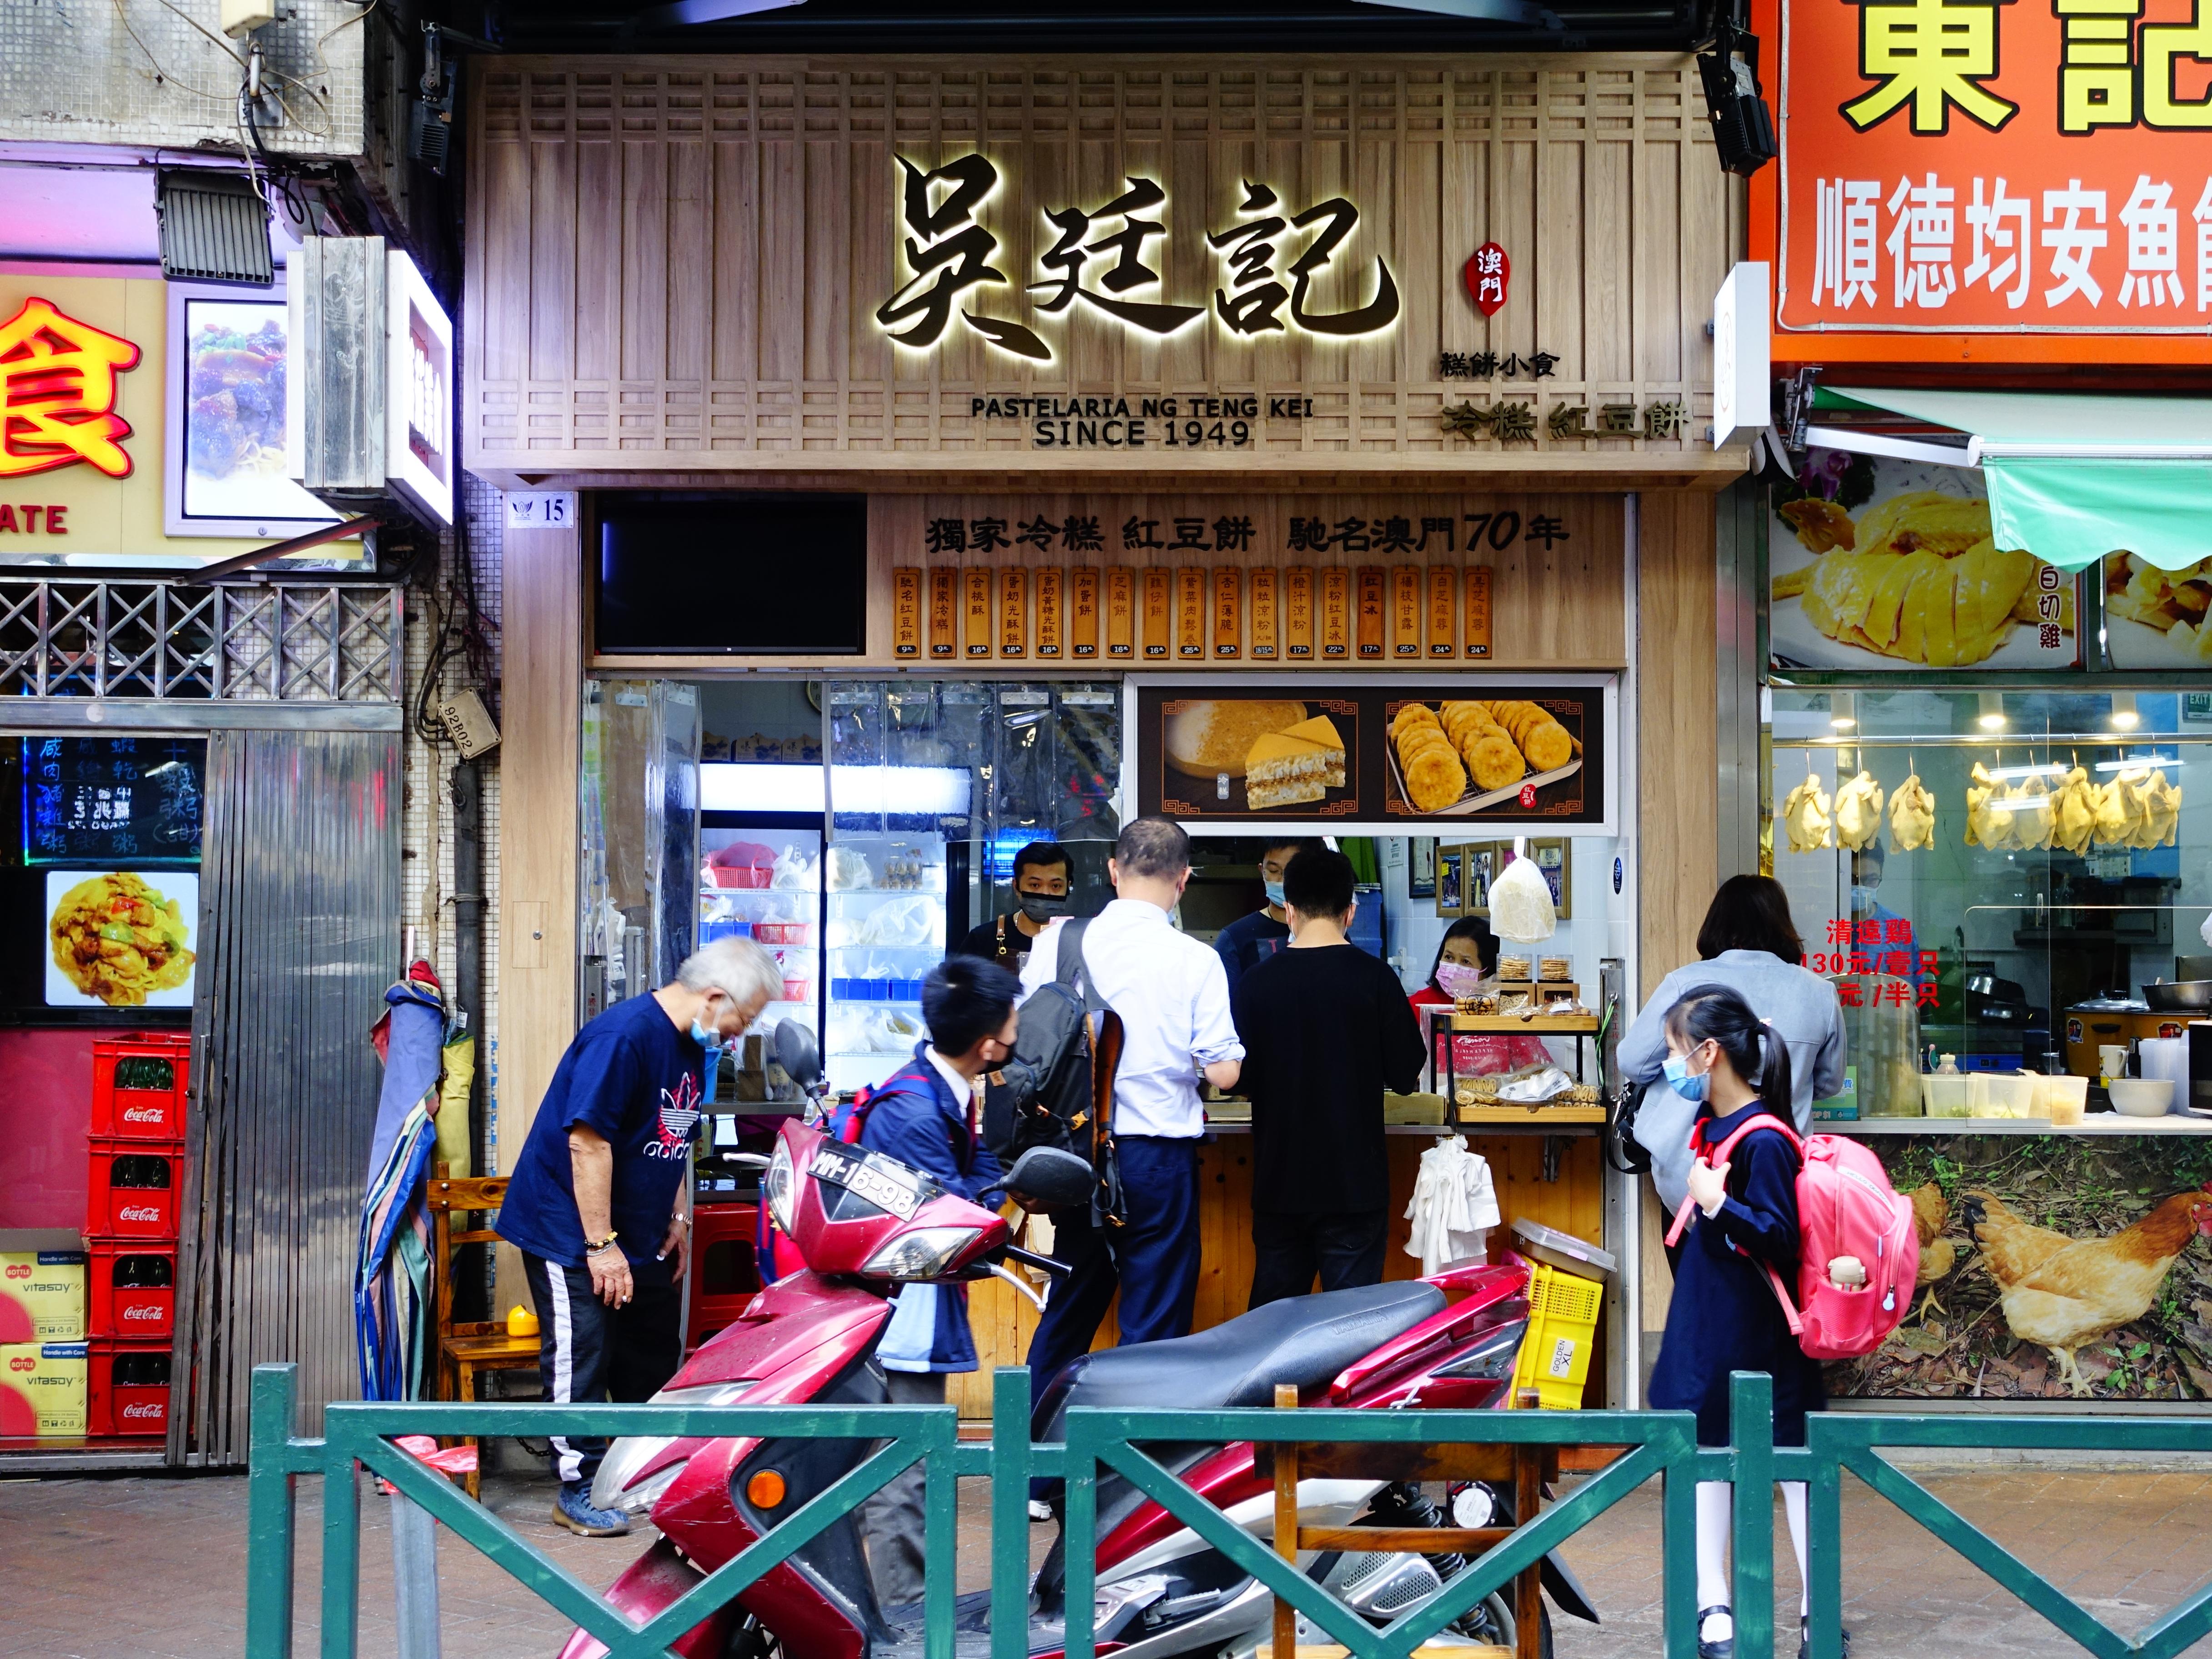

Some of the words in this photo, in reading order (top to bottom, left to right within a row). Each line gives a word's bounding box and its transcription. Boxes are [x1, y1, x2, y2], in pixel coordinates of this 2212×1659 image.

[1839, 0, 2212, 136] 東記
[877, 152, 1401, 361] 吳廷記
[1476, 247, 1503, 304] 澳門
[1440, 351, 1562, 378] 糕餅小食
[0, 297, 142, 479] 食
[972, 397, 1131, 418] PASTELARIA
[1142, 397, 1179, 418] NG
[1188, 397, 1258, 418] TENG
[1269, 397, 1314, 418] KEI
[1035, 419, 1146, 447] SINCE
[1164, 419, 1251, 447] 1949
[1441, 400, 1534, 441] 冷糕
[1548, 400, 1692, 441] 紅豆餅
[0, 505, 68, 533] ATE
[544, 498, 563, 521] 15
[925, 514, 1106, 553] 獨家冷糕
[1122, 514, 1257, 553] 紅豆餅
[1287, 511, 1570, 553] 馳名澳門70年
[900, 577, 913, 642] 馳名紅豆餅
[936, 577, 949, 630] 獨家冷糕
[971, 577, 985, 615] 合桃酥
[1006, 577, 1020, 644] 蛋奶光酥餅
[1078, 578, 1092, 616] 加蛋餅
[1114, 577, 1127, 617] 芝麻餅
[1220, 578, 1234, 630] 杏仁薄脆
[1257, 578, 1270, 630] 粒粒涼粉
[1292, 577, 1306, 630] 橙汁涼粉
[1328, 576, 1342, 640] 涼粉紅豆冰
[1364, 577, 1378, 615] 紅豆冰
[1400, 577, 1413, 630] 楊枝甘露
[1435, 577, 1448, 630] 白芝麻蓉
[2038, 564, 2062, 649] 白切雞
[2189, 694, 2208, 705] EXIT
[444, 706, 473, 750] 92B02
[1218, 775, 1228, 796] 冷糕
[1522, 786, 1531, 805] 紅豆餅
[810, 1151, 915, 1214] MM-16-98
[23, 1283, 70, 1293] vitasoy
[1553, 1339, 1565, 1372] GOLDEN
[1561, 1348, 1573, 1367] XL
[27, 1377, 73, 1387] vitasoy
